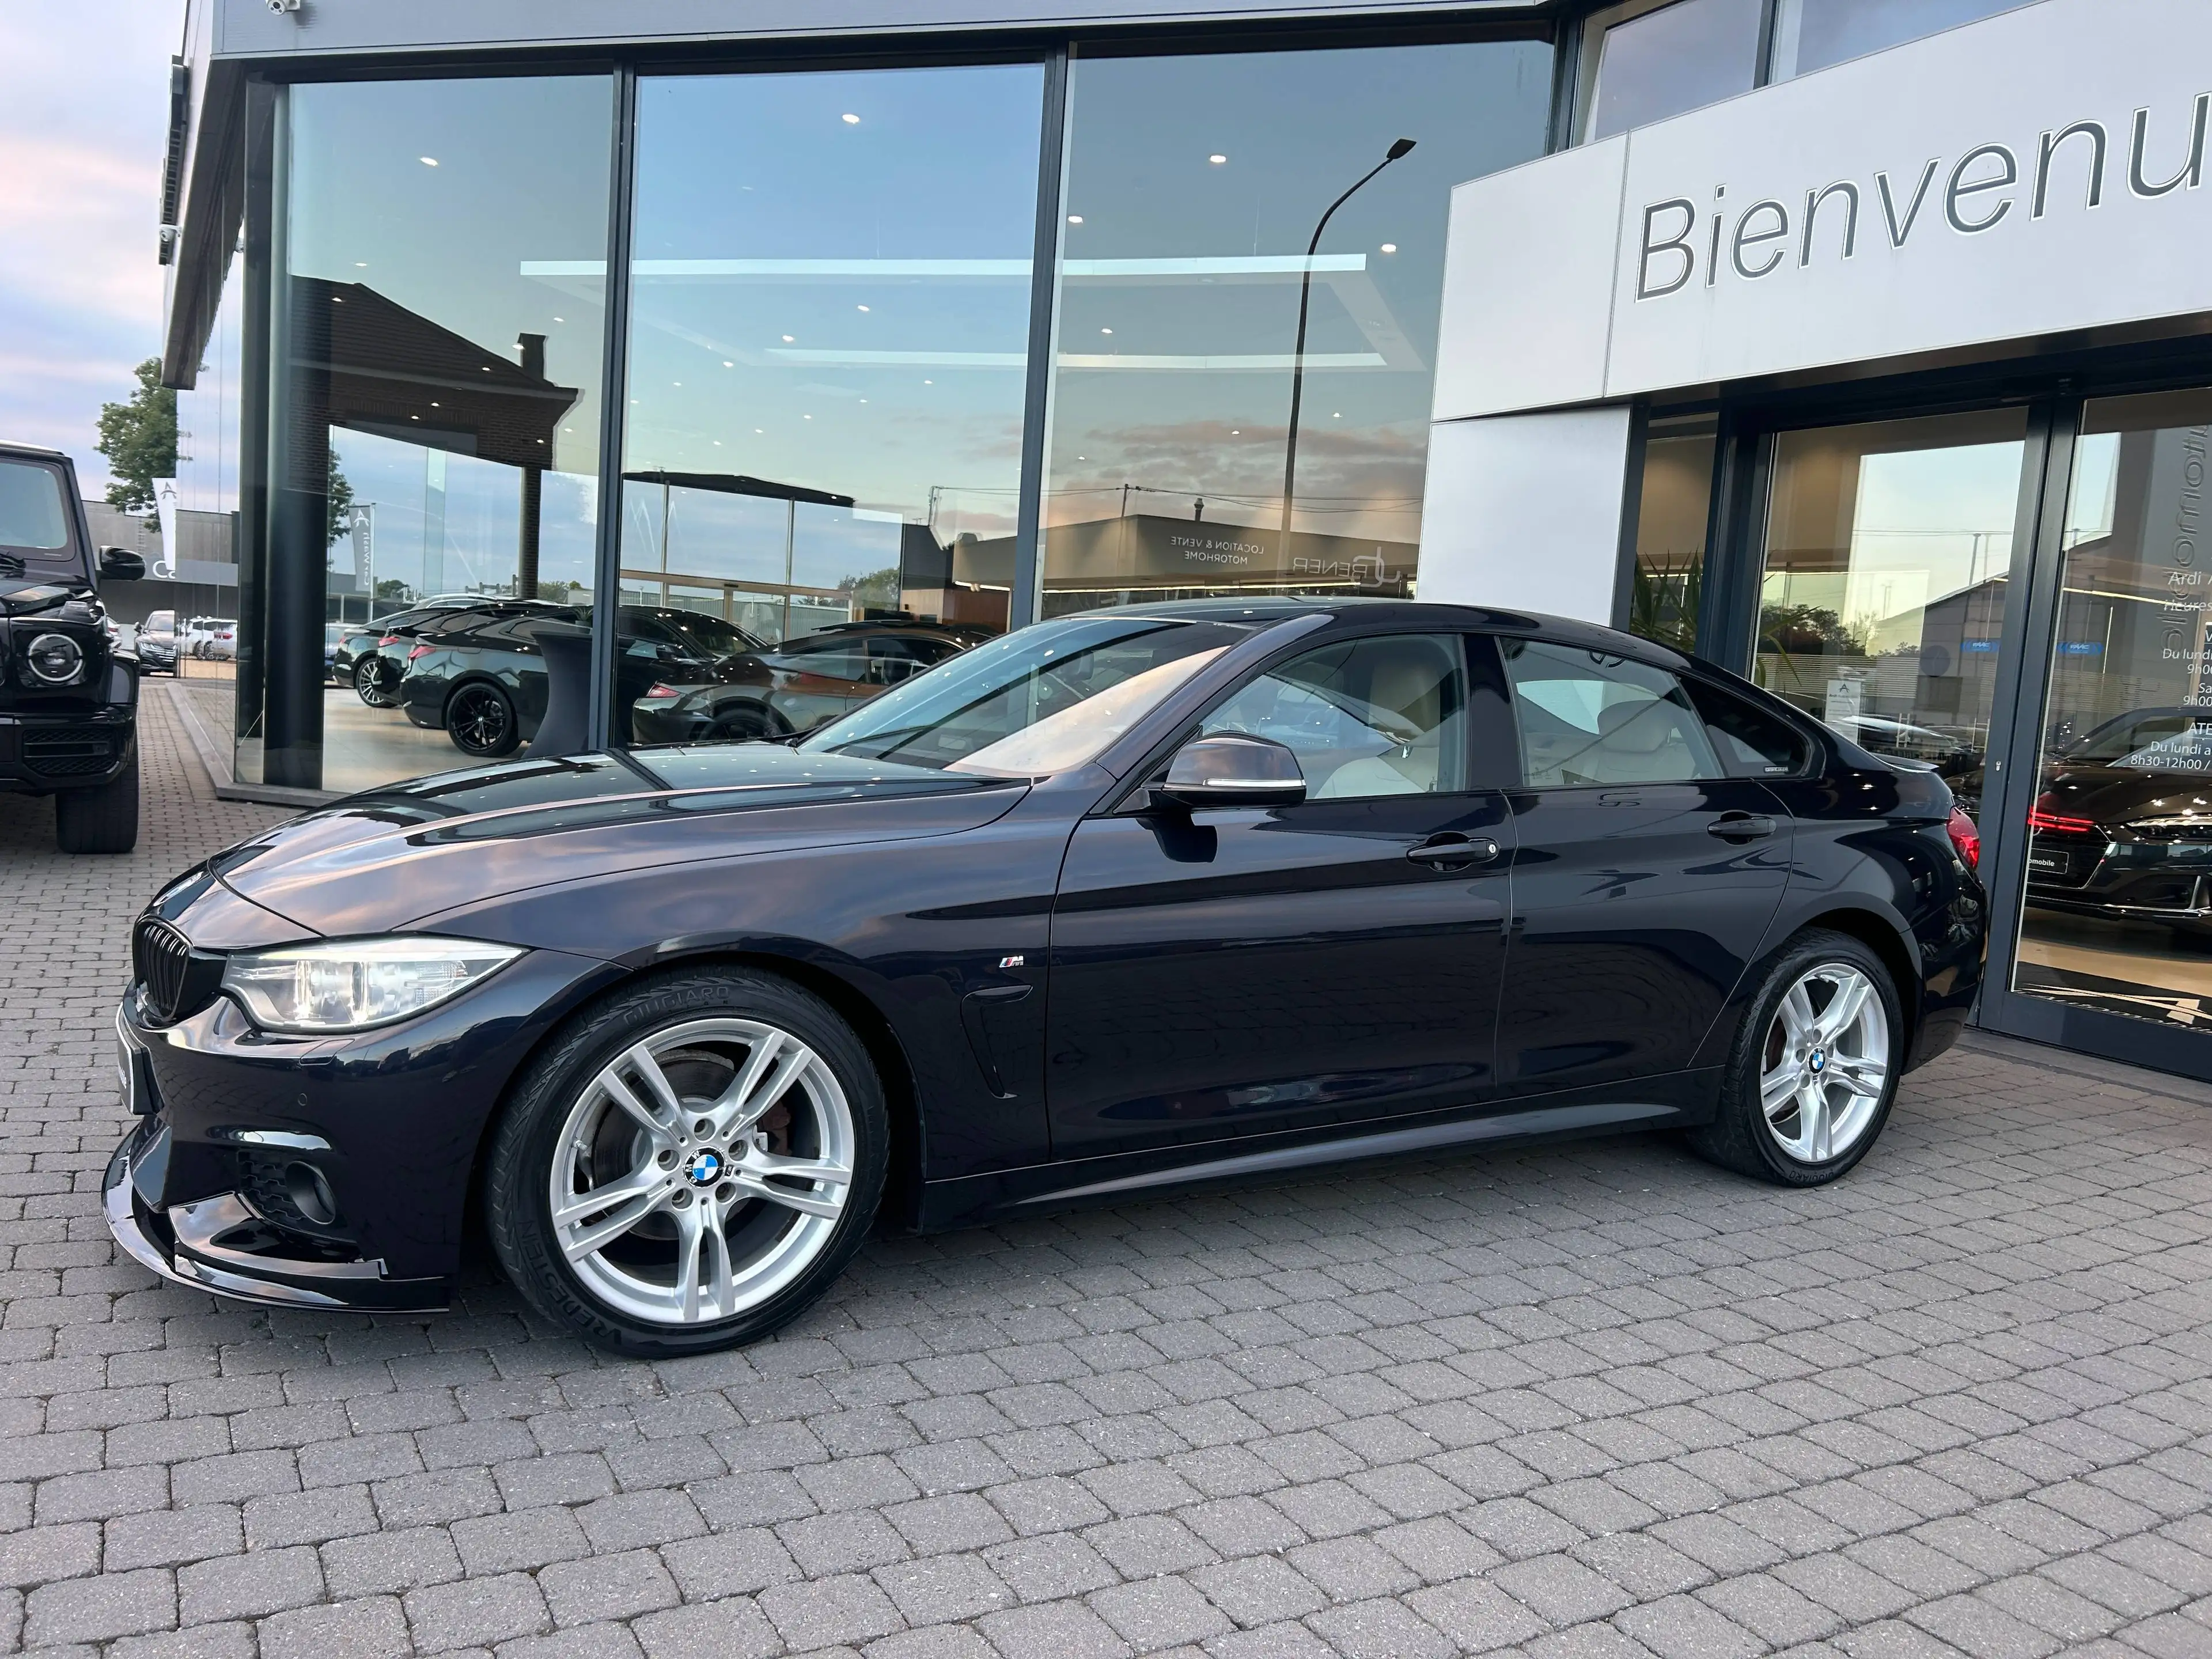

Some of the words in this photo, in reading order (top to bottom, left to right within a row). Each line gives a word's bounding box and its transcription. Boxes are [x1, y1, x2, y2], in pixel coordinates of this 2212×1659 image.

[1635, 91, 2212, 303] Bienvenu
[2168, 571, 2202, 585] Ardi
[2163, 649, 2180, 659] Du
[2183, 695, 2212, 706] 9h00
[2187, 722, 2212, 735] ATE
[2150, 741, 2167, 752] Du
[2171, 742, 2201, 755] lundi
[2131, 755, 2202, 770] 8h30-12h00
